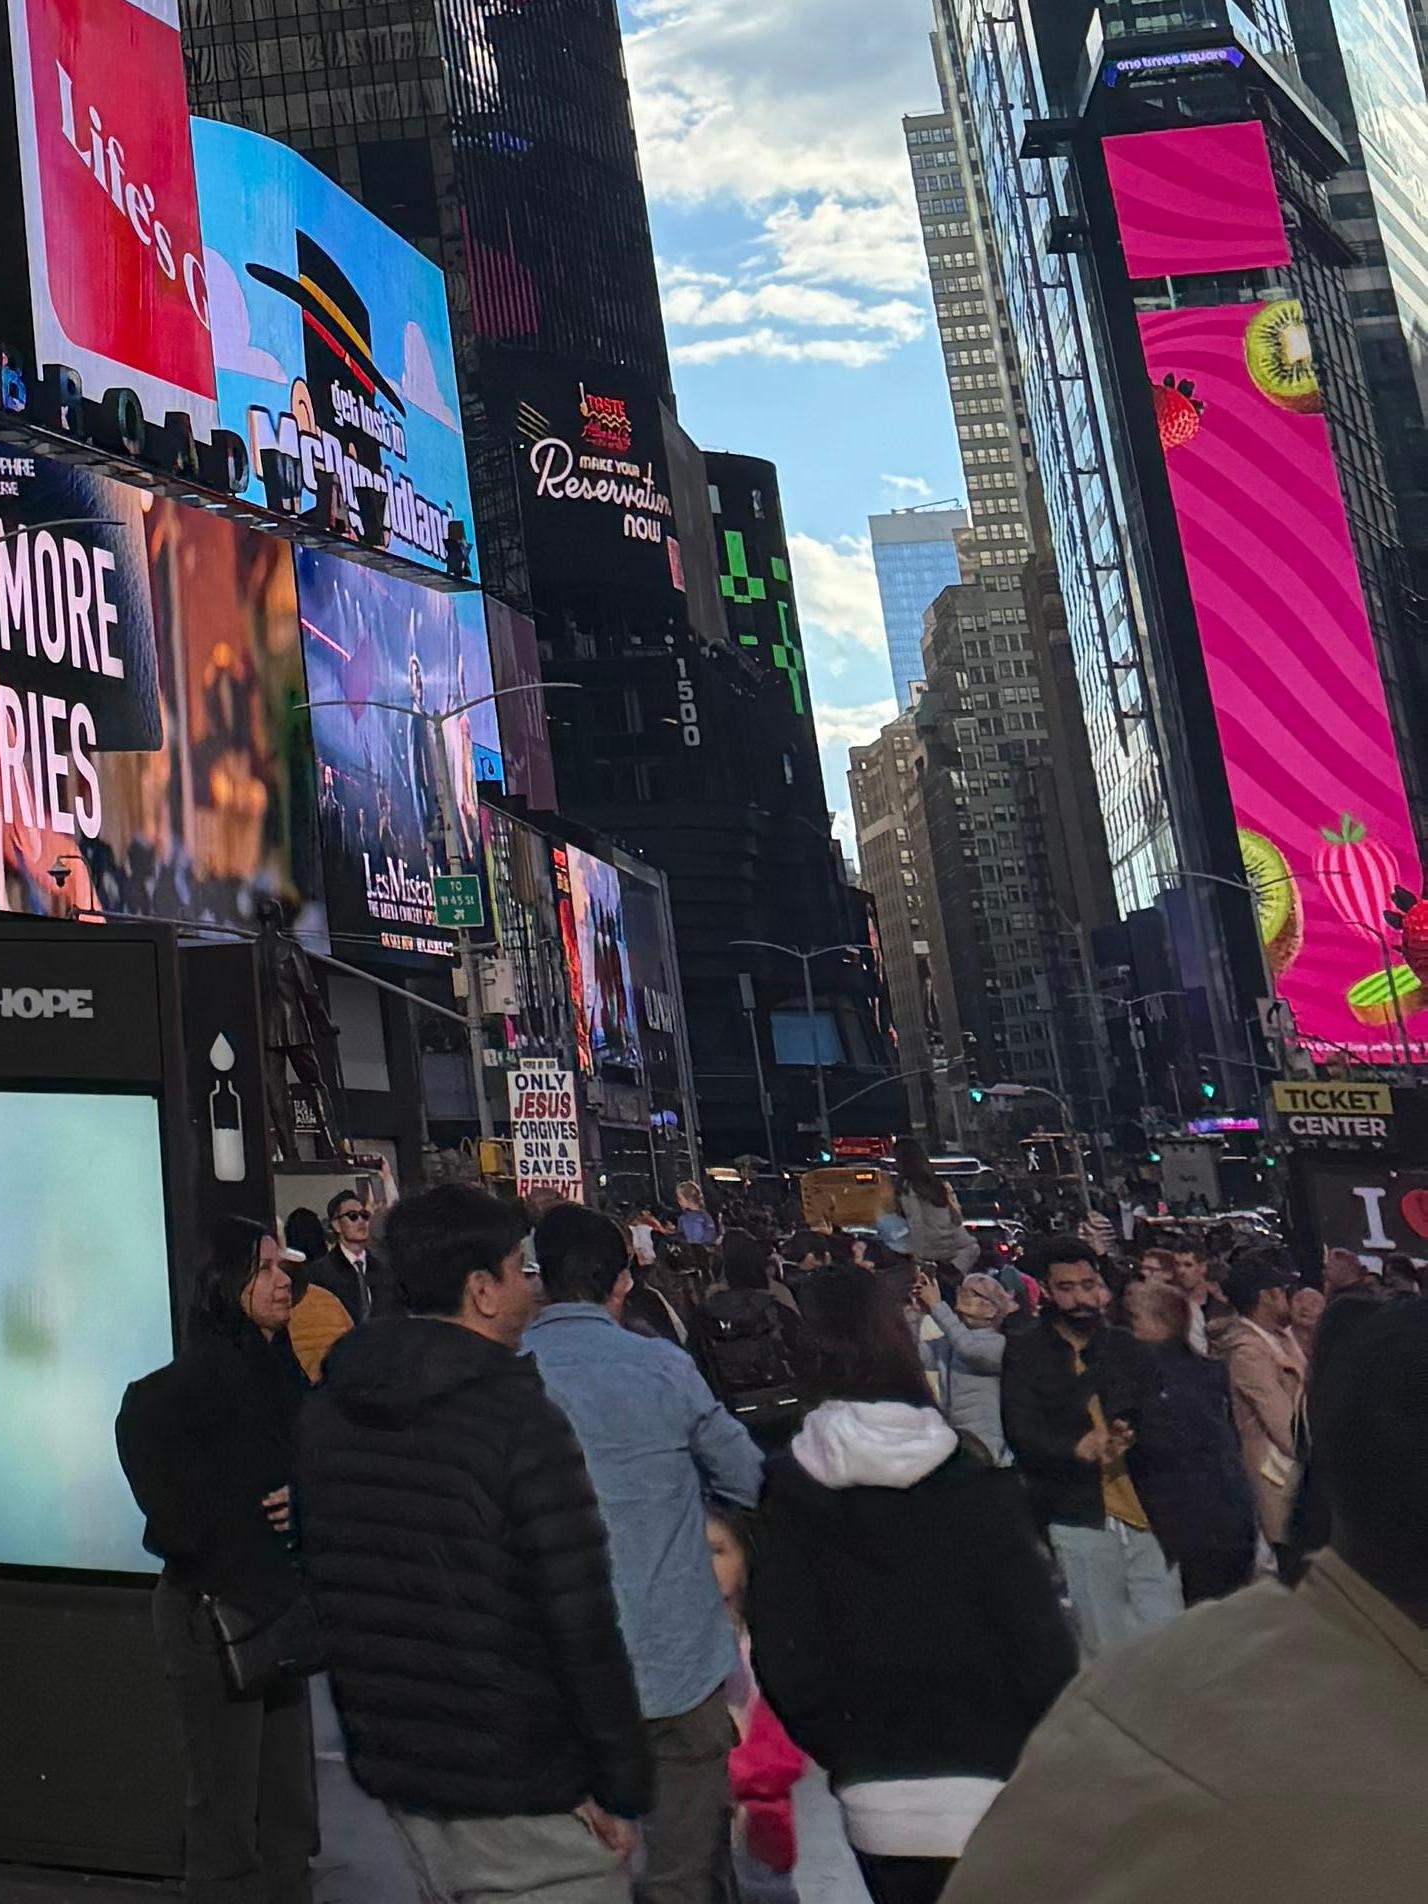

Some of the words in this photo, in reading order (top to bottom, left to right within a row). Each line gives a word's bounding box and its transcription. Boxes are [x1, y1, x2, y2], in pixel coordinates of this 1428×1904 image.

[1116, 58, 1142, 71] one
[1142, 54, 1181, 68] times
[1180, 49, 1228, 65] square
[57, 60, 175, 281] Life's
[331, 379, 360, 428] get
[358, 394, 392, 449] lost
[390, 418, 407, 459] in
[530, 437, 672, 517] Reservation
[579, 455, 613, 472] MAKE
[614, 459, 640, 478] YOUR
[675, 657, 701, 747] 1500
[449, 880, 463, 892] TO
[515, 1073, 567, 1091] ONLY
[514, 1092, 572, 1120] JESUS
[1284, 1088, 1381, 1112] TICKET
[511, 1120, 578, 1141] FORGIVES
[1288, 1115, 1389, 1137] CENTER
[524, 1142, 552, 1158] SIN
[557, 1142, 569, 1158] &
[519, 1159, 577, 1177] SAVES
[1351, 1187, 1397, 1249] I
